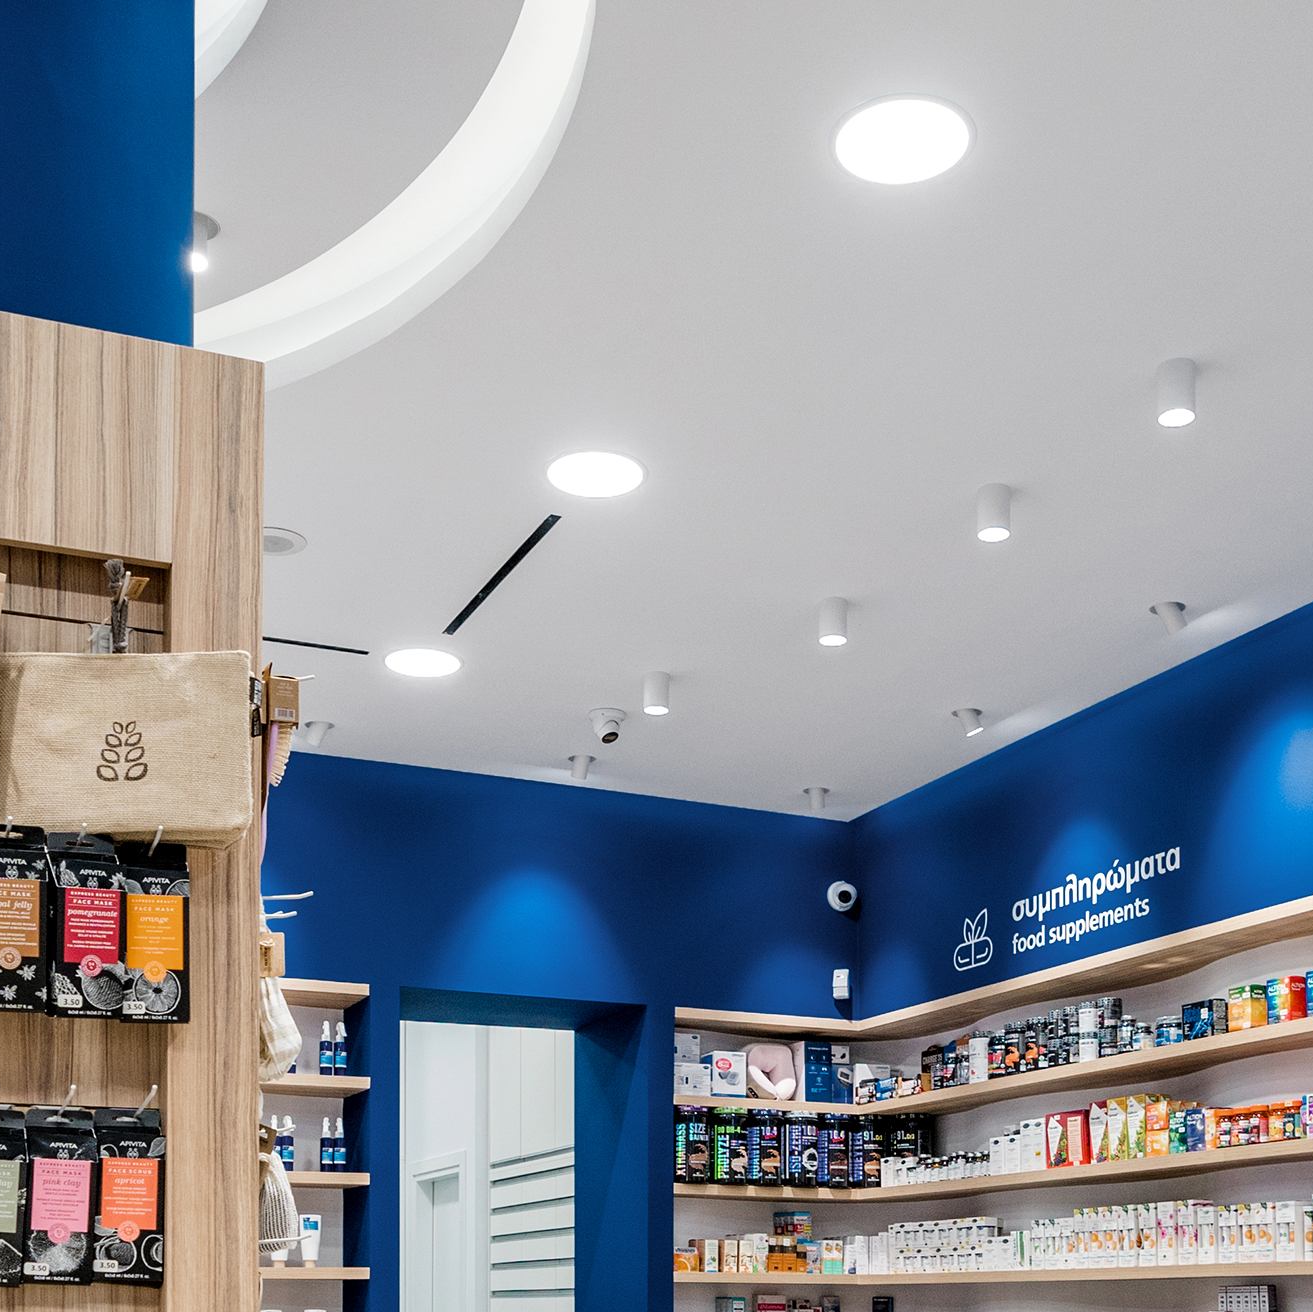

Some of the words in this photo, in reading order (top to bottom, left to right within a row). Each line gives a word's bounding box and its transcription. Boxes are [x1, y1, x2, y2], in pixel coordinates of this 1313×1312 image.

[79, 869, 107, 878] APIVITA
[142, 877, 170, 885] APIVITA
[1011, 844, 1182, 924] συμπληρώματα
[13, 901, 33, 910] jelly
[67, 909, 117, 918] pomegranate
[140, 916, 169, 925] orange
[1011, 924, 1044, 957] food
[1049, 897, 1150, 948] supplements
[63, 998, 79, 1006] 3.50
[127, 1003, 142, 1011] 3.50
[50, 1142, 77, 1150] APIVITA
[120, 1140, 147, 1149] APIVITA
[42, 1178, 61, 1187] pink
[63, 1178, 81, 1187] clay
[115, 1177, 145, 1186] apricot
[31, 1265, 46, 1273] 3.50
[100, 1262, 115, 1270] 3.50
